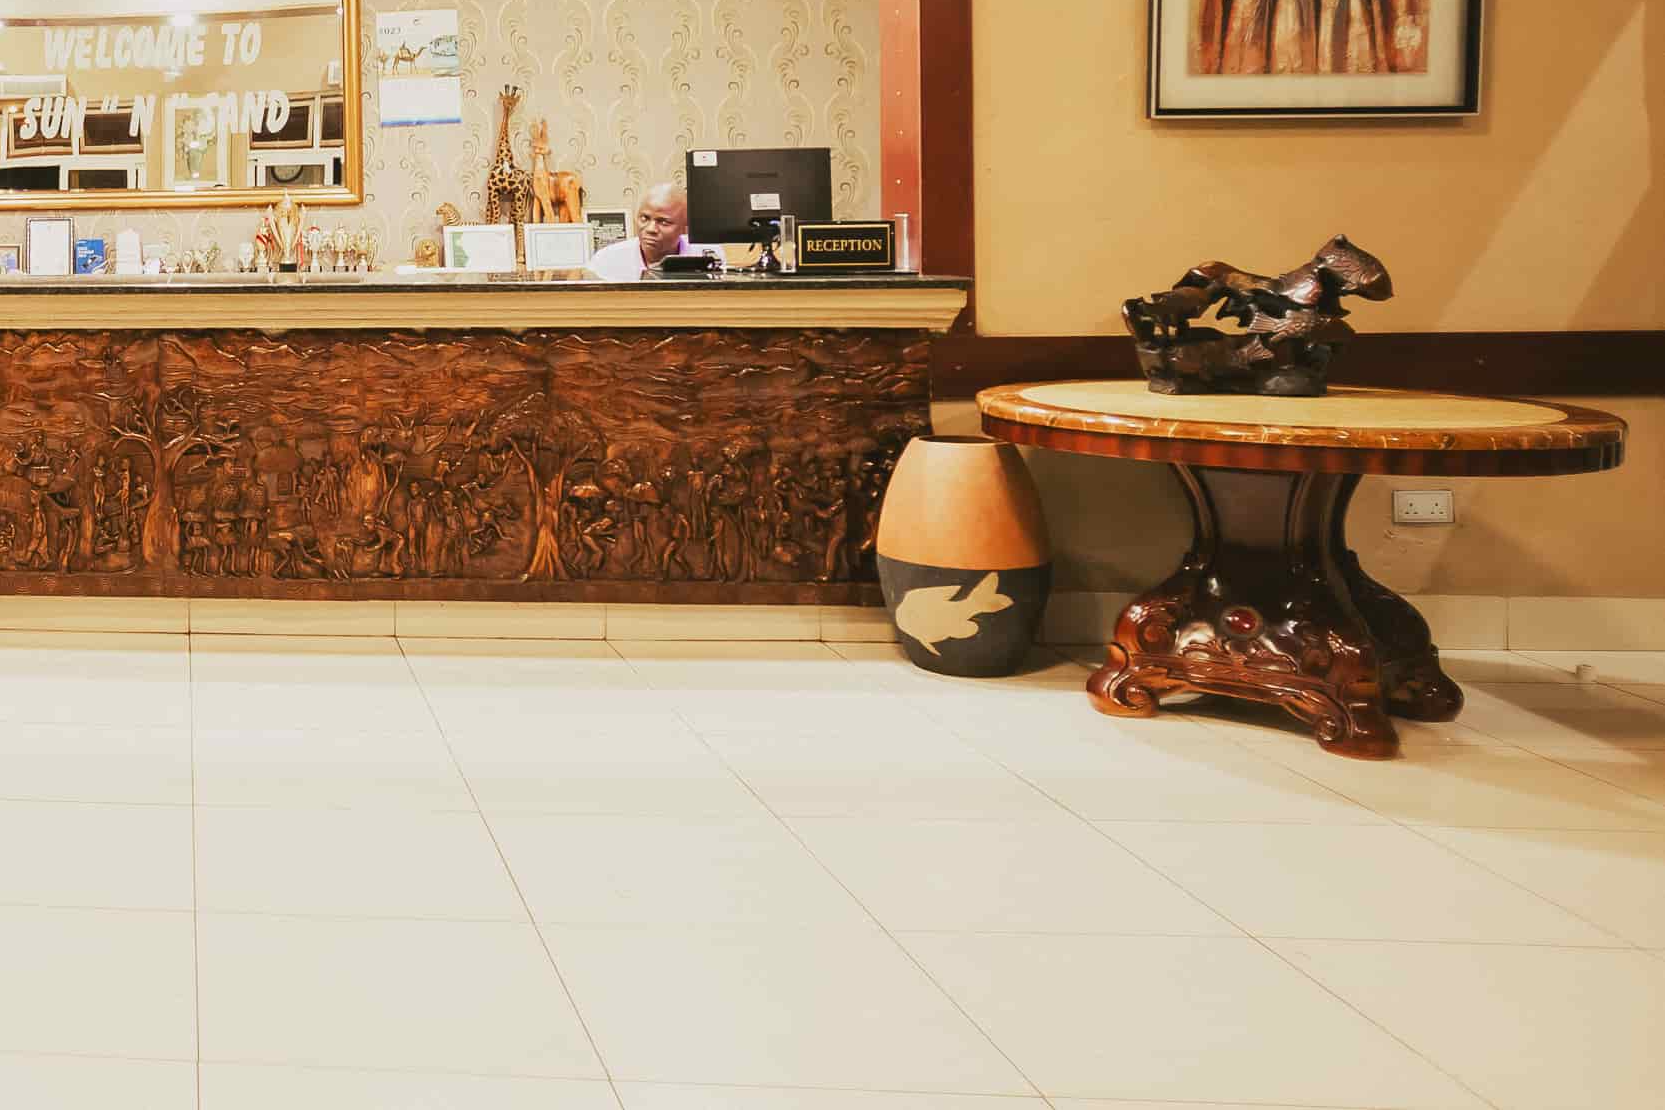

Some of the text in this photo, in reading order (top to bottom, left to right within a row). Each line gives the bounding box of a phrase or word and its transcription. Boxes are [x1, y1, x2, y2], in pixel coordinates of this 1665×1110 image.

[42, 23, 262, 69] WELCOME TO
[19, 96, 87, 140] SUN
[196, 90, 291, 134] SAND
[807, 238, 883, 252] RECEPTION
